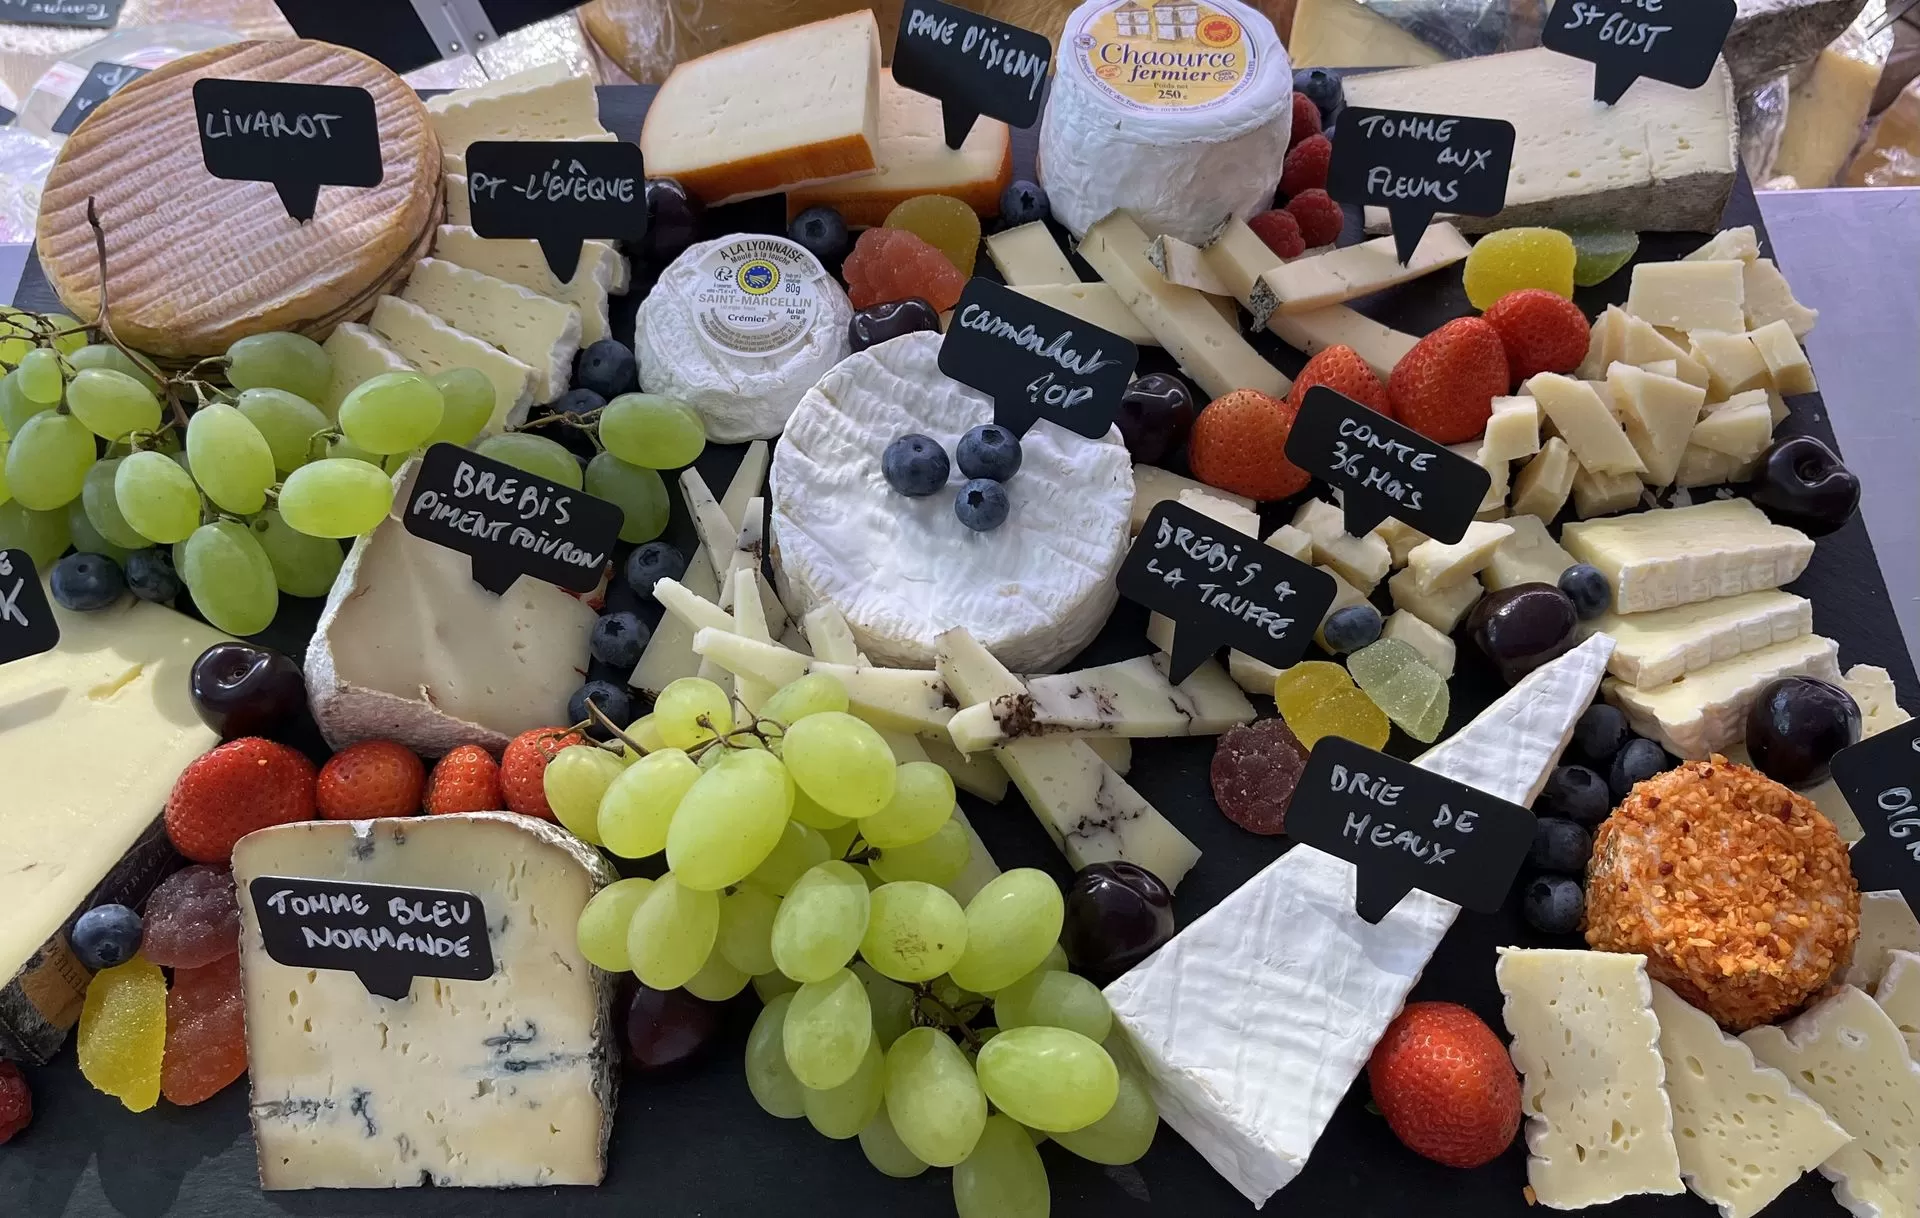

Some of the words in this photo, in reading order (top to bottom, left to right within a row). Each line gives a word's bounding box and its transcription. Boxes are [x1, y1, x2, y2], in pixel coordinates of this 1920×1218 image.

[1101, 43, 1236, 68] Chaource
[1127, 64, 1211, 83] fermier
[1158, 90, 1181, 99] 250
[1358, 115, 1460, 143] TOMME
[1437, 147, 1492, 174] AUX
[729, 243, 744, 255] LA
[747, 241, 804, 263] LYONNAISE
[769, 252, 791, 265] louche
[699, 293, 812, 307] SAINT-MARCELLIN
[785, 283, 800, 295] 80g
[728, 313, 767, 322] Crémier
[1339, 418, 1437, 472] COMTE
[1329, 441, 1364, 478] 36
[1146, 558, 1187, 589] LA
[1198, 583, 1295, 640] TRUFFE
[1432, 803, 1479, 833] DE
[267, 889, 370, 916] TOMME
[301, 926, 471, 958] NORMANDE
